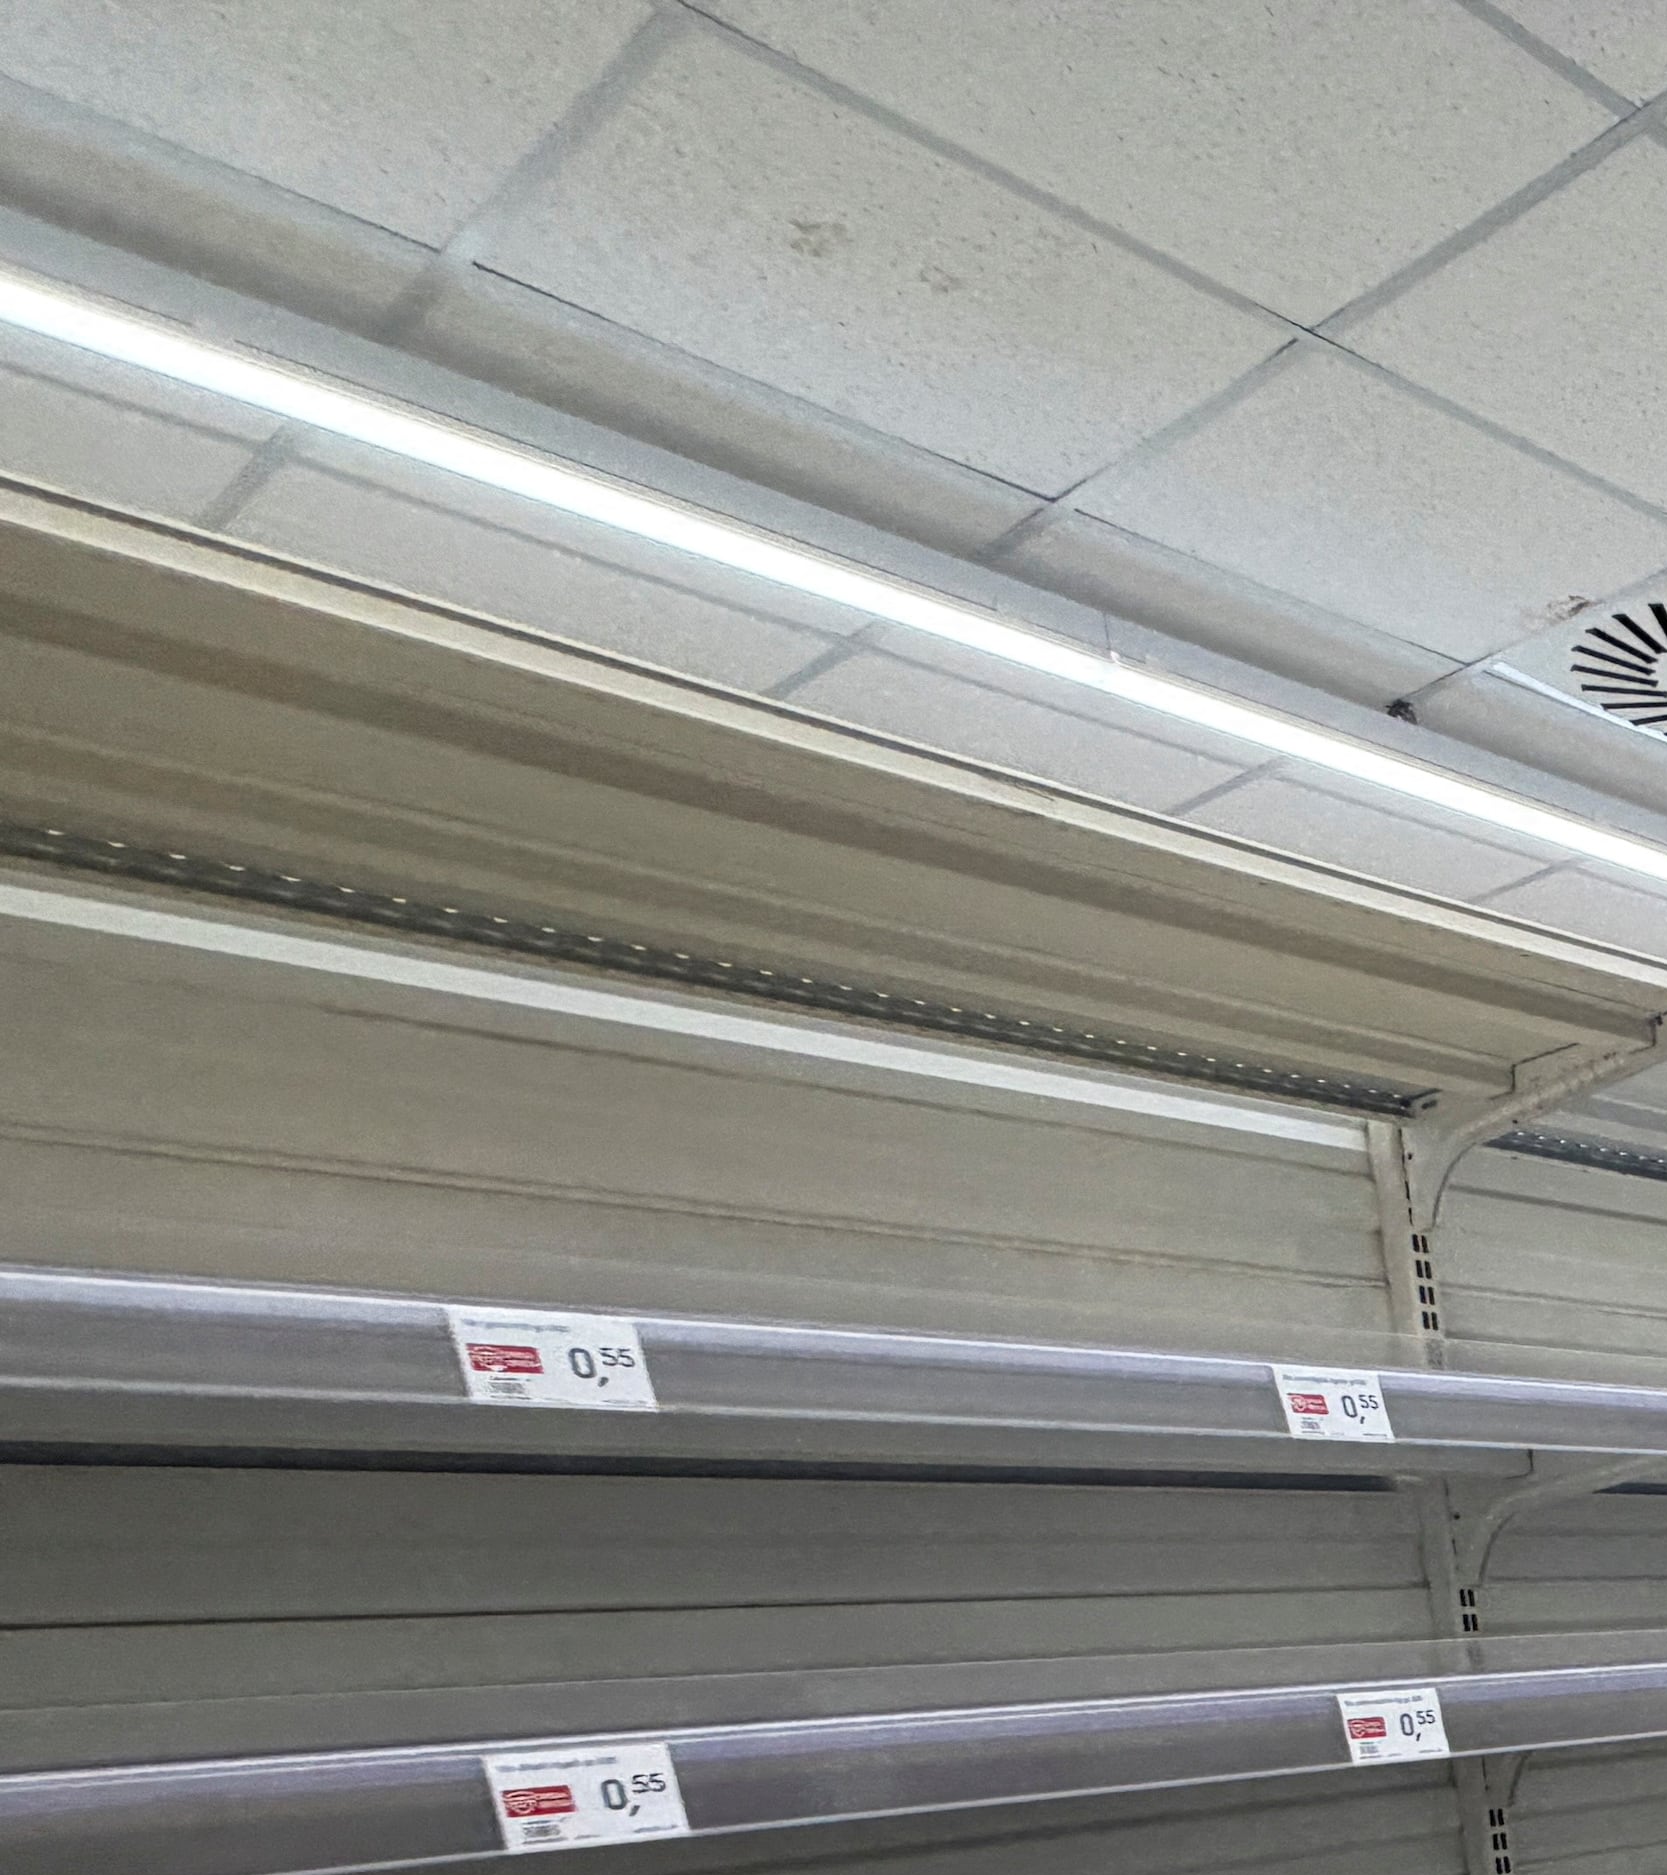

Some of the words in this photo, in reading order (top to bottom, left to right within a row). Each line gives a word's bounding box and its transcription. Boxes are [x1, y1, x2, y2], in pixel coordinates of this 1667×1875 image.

[568, 1347, 635, 1388] 0,55
[1341, 1394, 1379, 1425] 0,55
[1400, 1709, 1436, 1742] 0,55
[600, 1772, 666, 1817] 0,55
